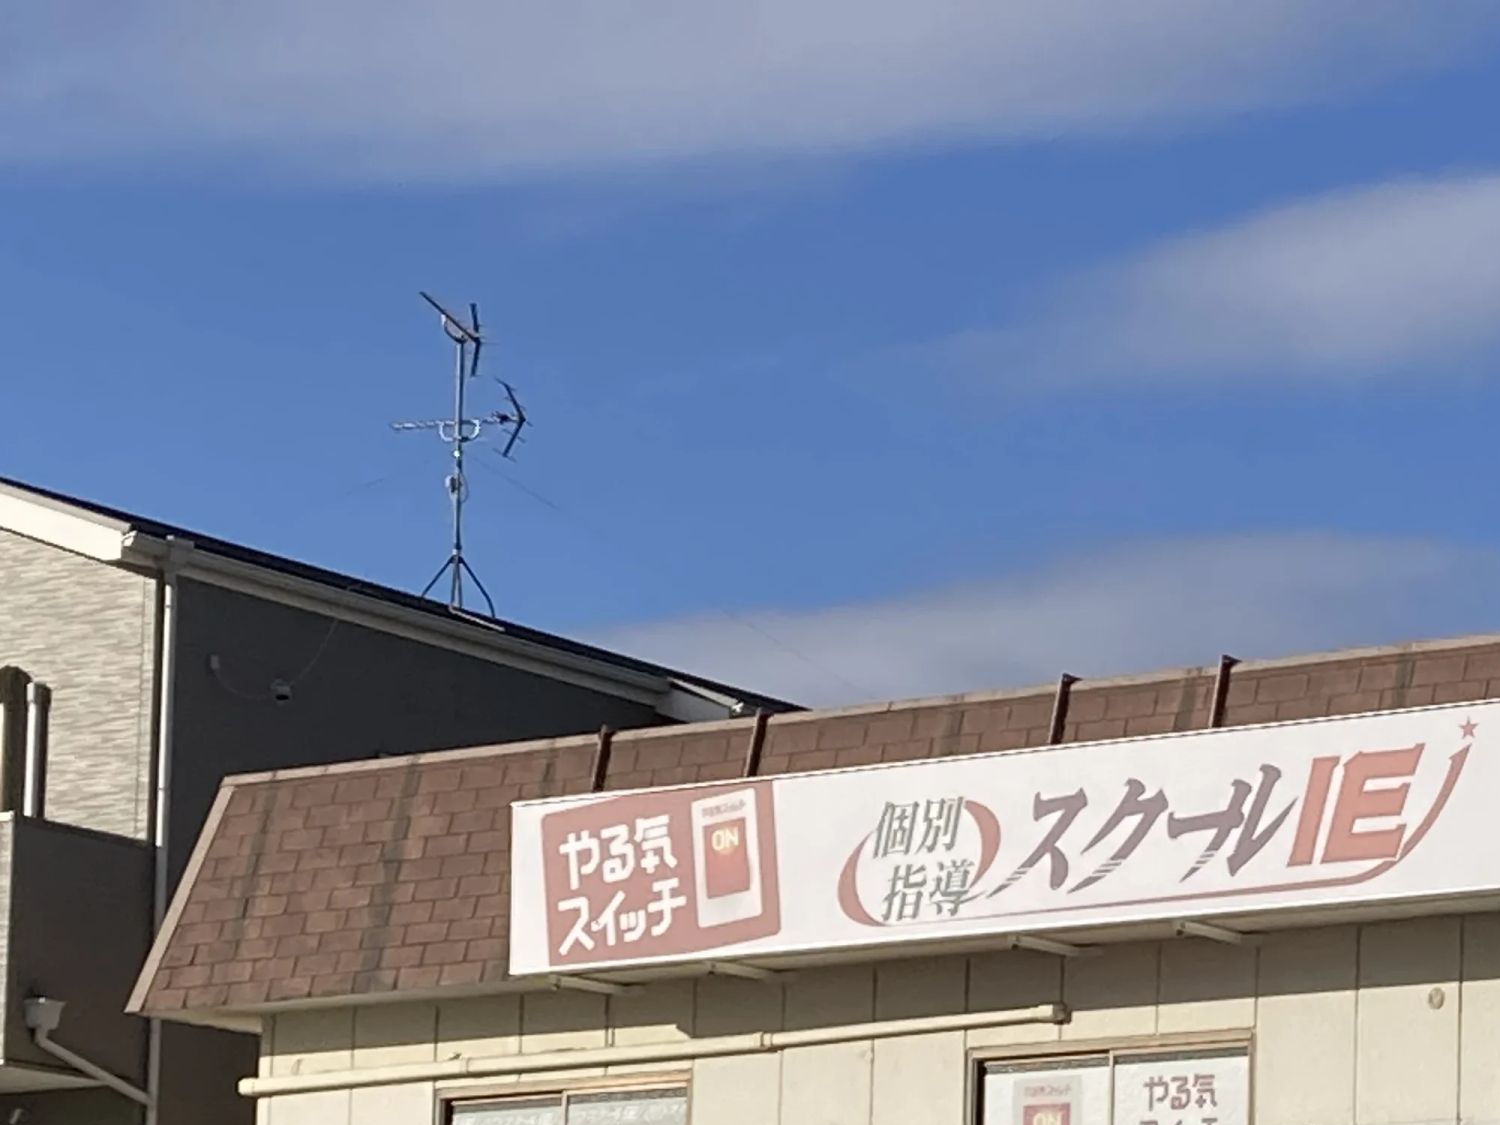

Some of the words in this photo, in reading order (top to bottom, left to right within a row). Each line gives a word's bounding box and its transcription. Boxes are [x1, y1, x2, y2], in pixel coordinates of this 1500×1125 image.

[559, 815, 677, 890] やる気
[711, 826, 740, 851] ON
[872, 796, 965, 858] 個別
[557, 878, 687, 956] スイッチ
[881, 858, 980, 924] 指導
[1144, 1074, 1218, 1112] やる気
